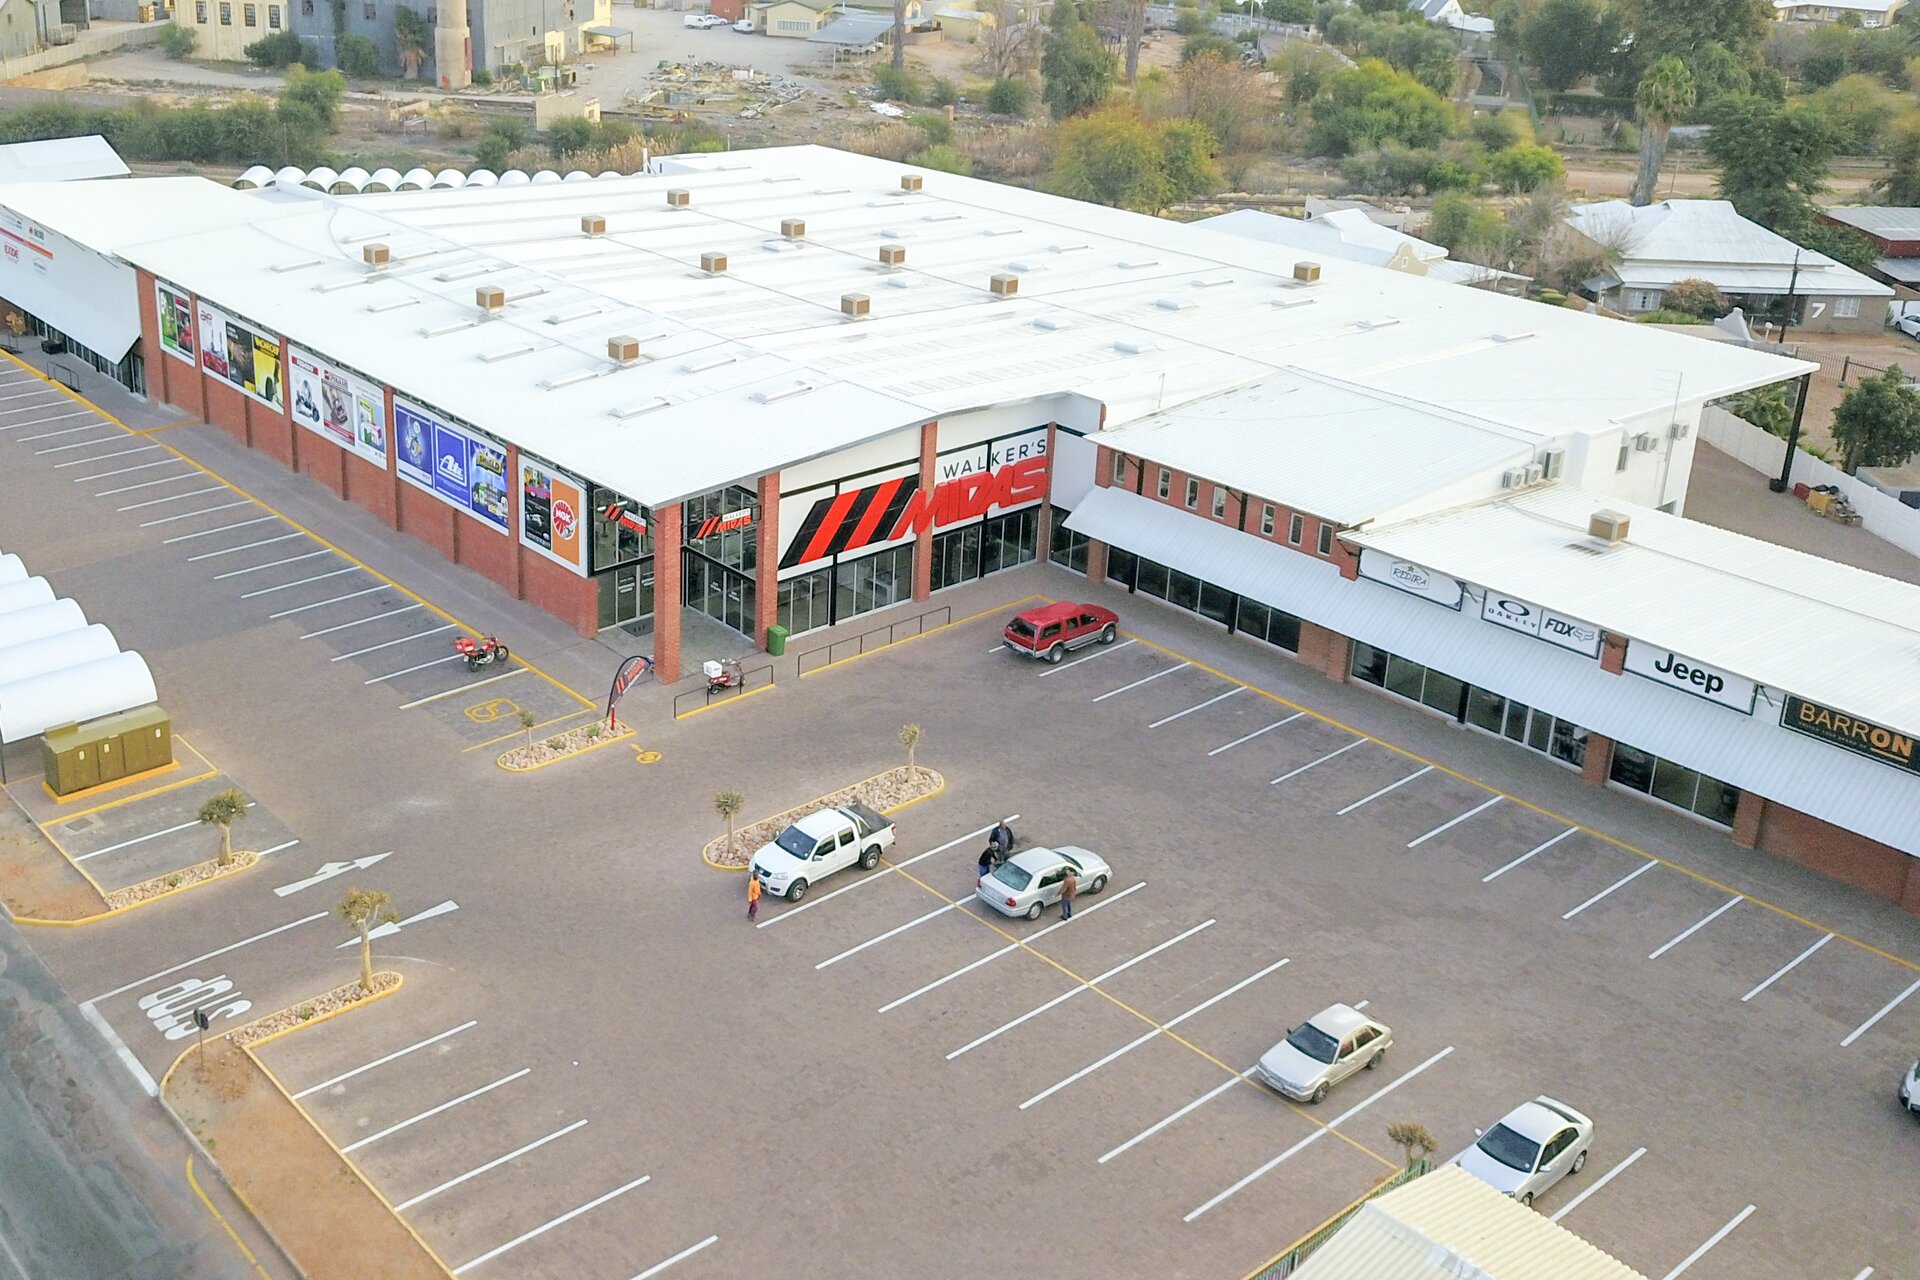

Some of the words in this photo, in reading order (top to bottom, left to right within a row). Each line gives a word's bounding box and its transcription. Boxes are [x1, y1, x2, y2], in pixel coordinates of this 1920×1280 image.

[1811, 302, 1826, 319] 7
[479, 454, 501, 472] SHIELD
[943, 439, 1046, 479] WALKER'S
[888, 455, 1049, 541] MIDAS
[716, 514, 752, 533] MIDAS
[1488, 607, 1537, 629] OAKLEY
[1544, 617, 1576, 638] FOX
[1655, 653, 1724, 694] Jeep
[1800, 702, 1914, 758] BARRON
[137, 973, 253, 1041] STOP
